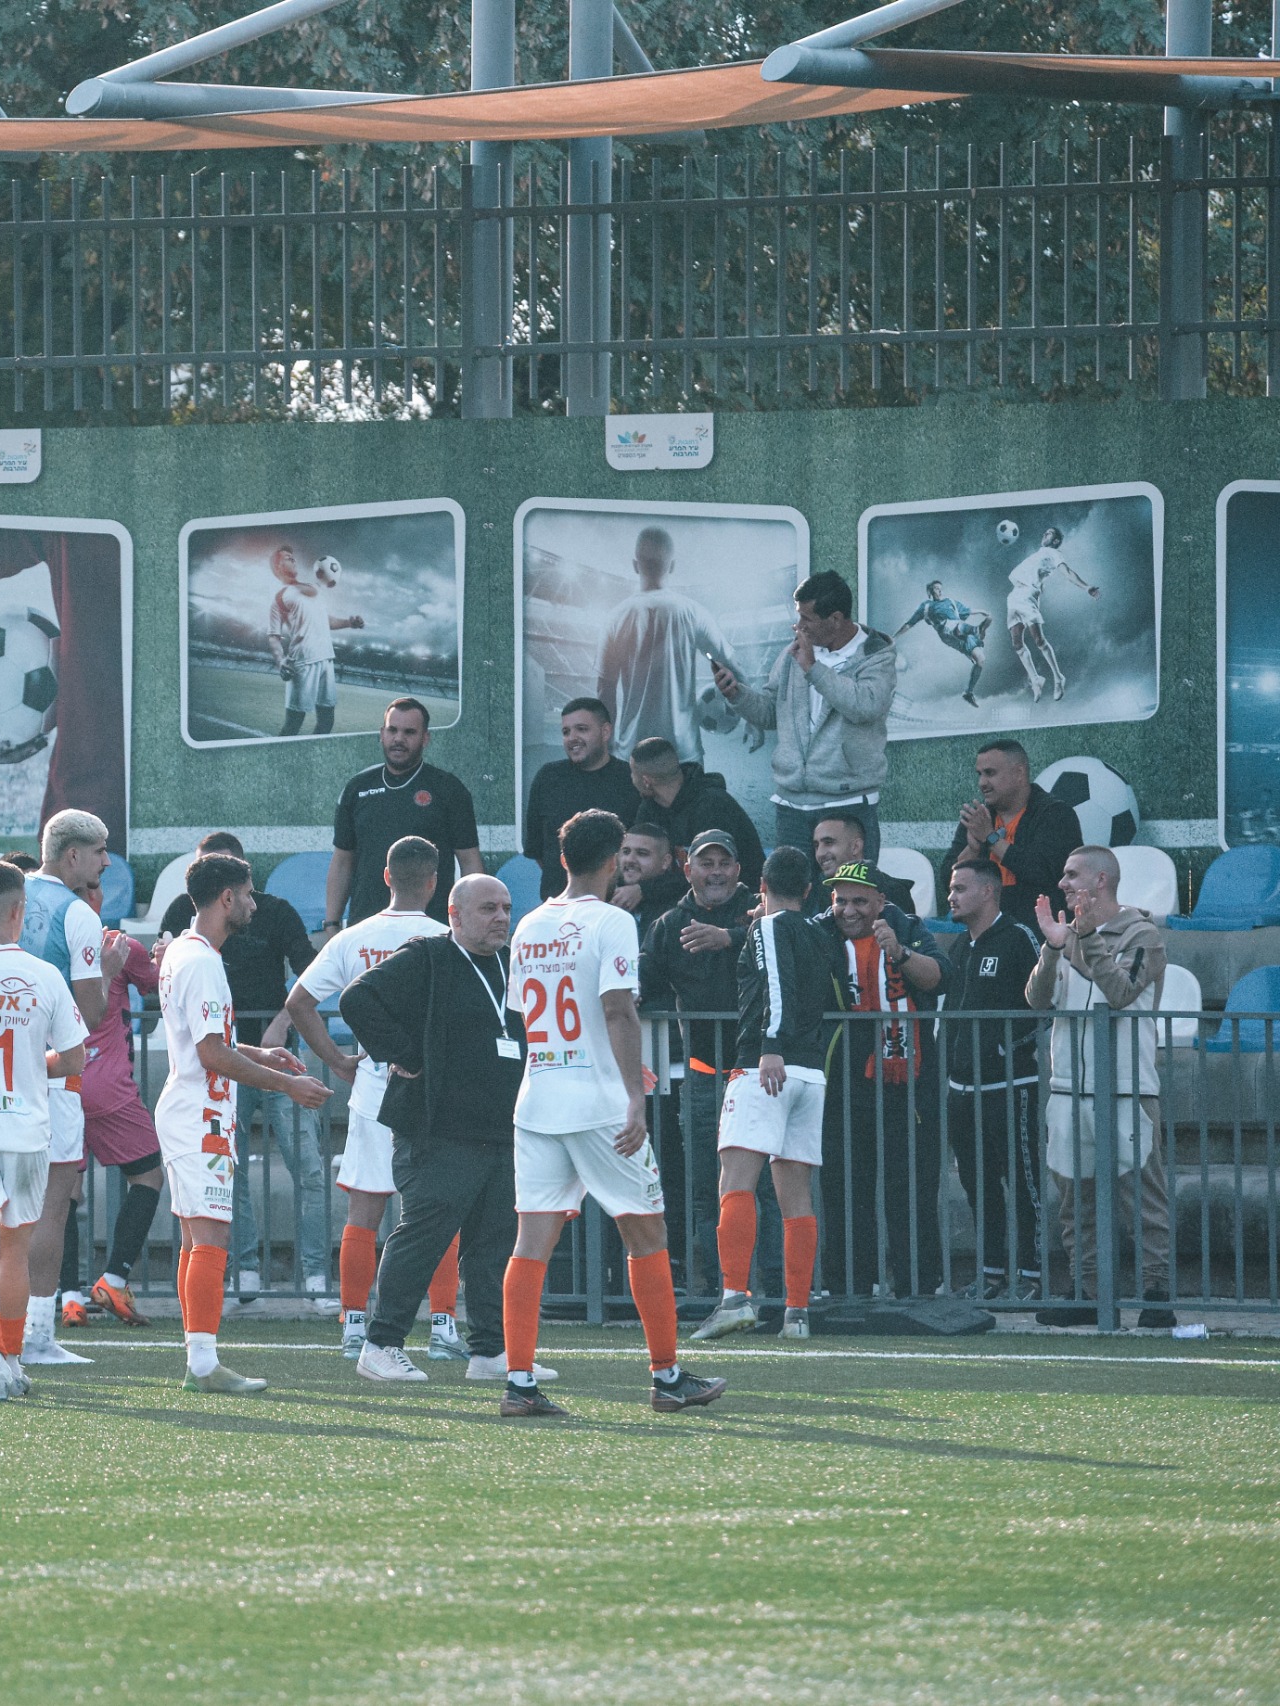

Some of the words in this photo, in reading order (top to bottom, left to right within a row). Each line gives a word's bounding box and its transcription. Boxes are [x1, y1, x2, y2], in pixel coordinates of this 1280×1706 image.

[835, 863, 869, 880] STYLE
[753, 928, 764, 971] GIVOVA
[523, 975, 581, 1044] 26
[4, 1015, 30, 1027] שיווק
[350, 1314, 365, 1323] FS
